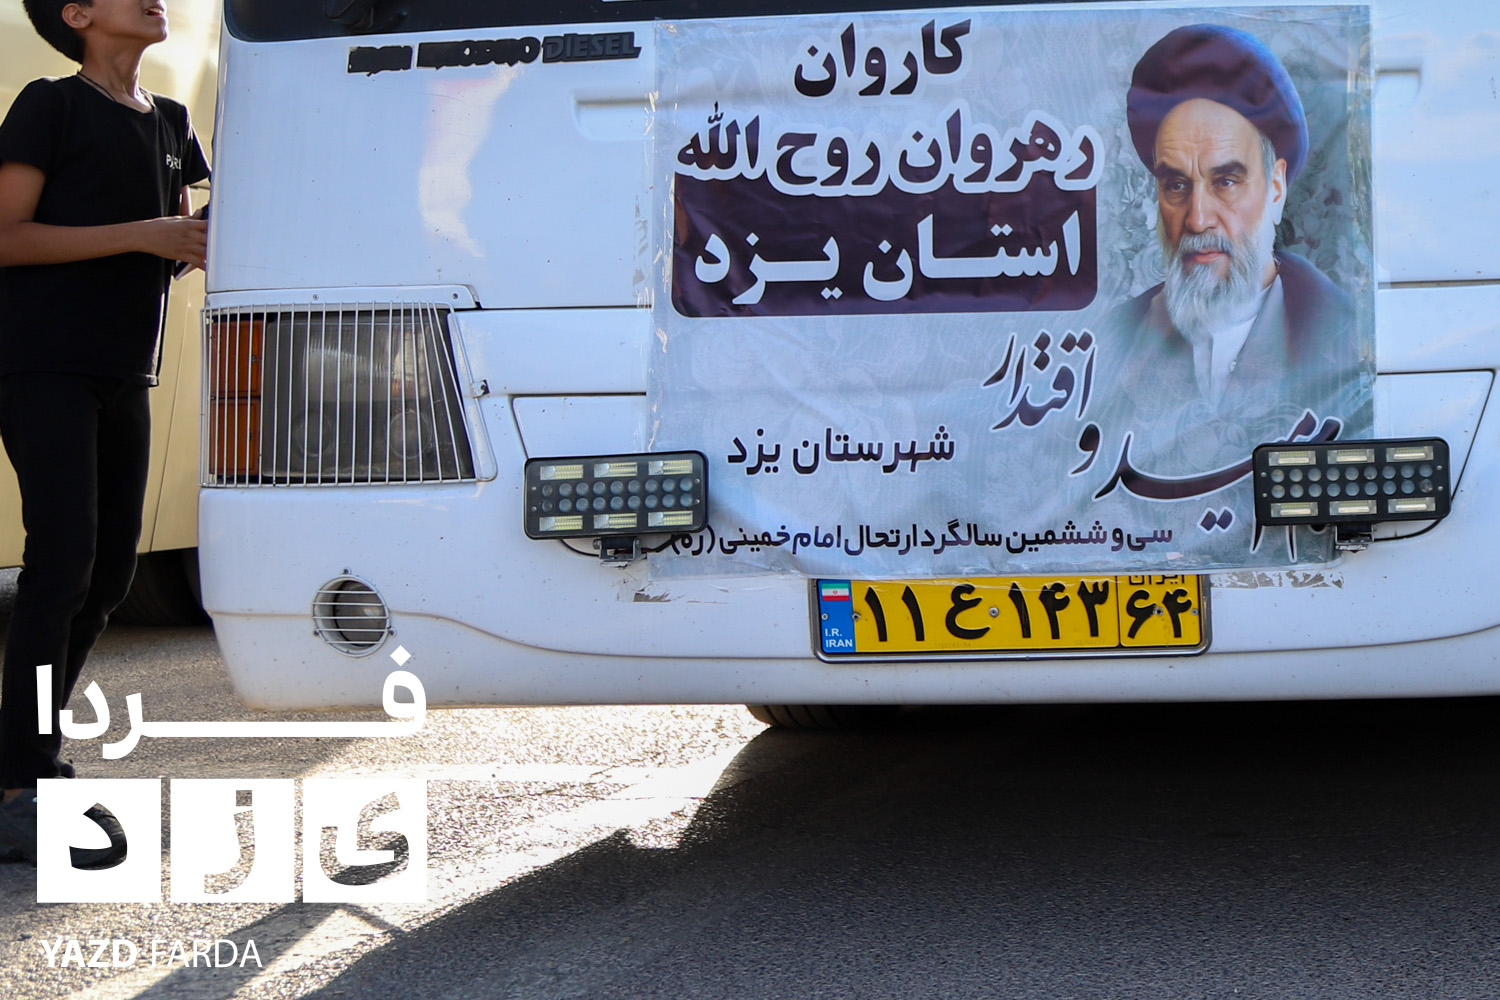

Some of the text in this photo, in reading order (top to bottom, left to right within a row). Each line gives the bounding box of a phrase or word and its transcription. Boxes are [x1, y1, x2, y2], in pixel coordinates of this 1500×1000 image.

[543, 32, 642, 64] DIESEL
[792, 17, 972, 97] کاروان
[677, 101, 1097, 187] رهروان روح الله
[694, 209, 1082, 306] استان یزد
[982, 330, 1097, 431] اقتدار
[727, 425, 955, 476] شهرستان یزد
[718, 524, 791, 555] خمینی
[792, 524, 842, 554] امام
[843, 523, 918, 556] ارتحال
[920, 518, 1002, 555] سالگرد
[1005, 520, 1108, 554] ششمین
[1110, 527, 1125, 551] و
[1126, 527, 1173, 552] سی
[825, 628, 843, 637] I.R.
[825, 638, 853, 648] IRAN
